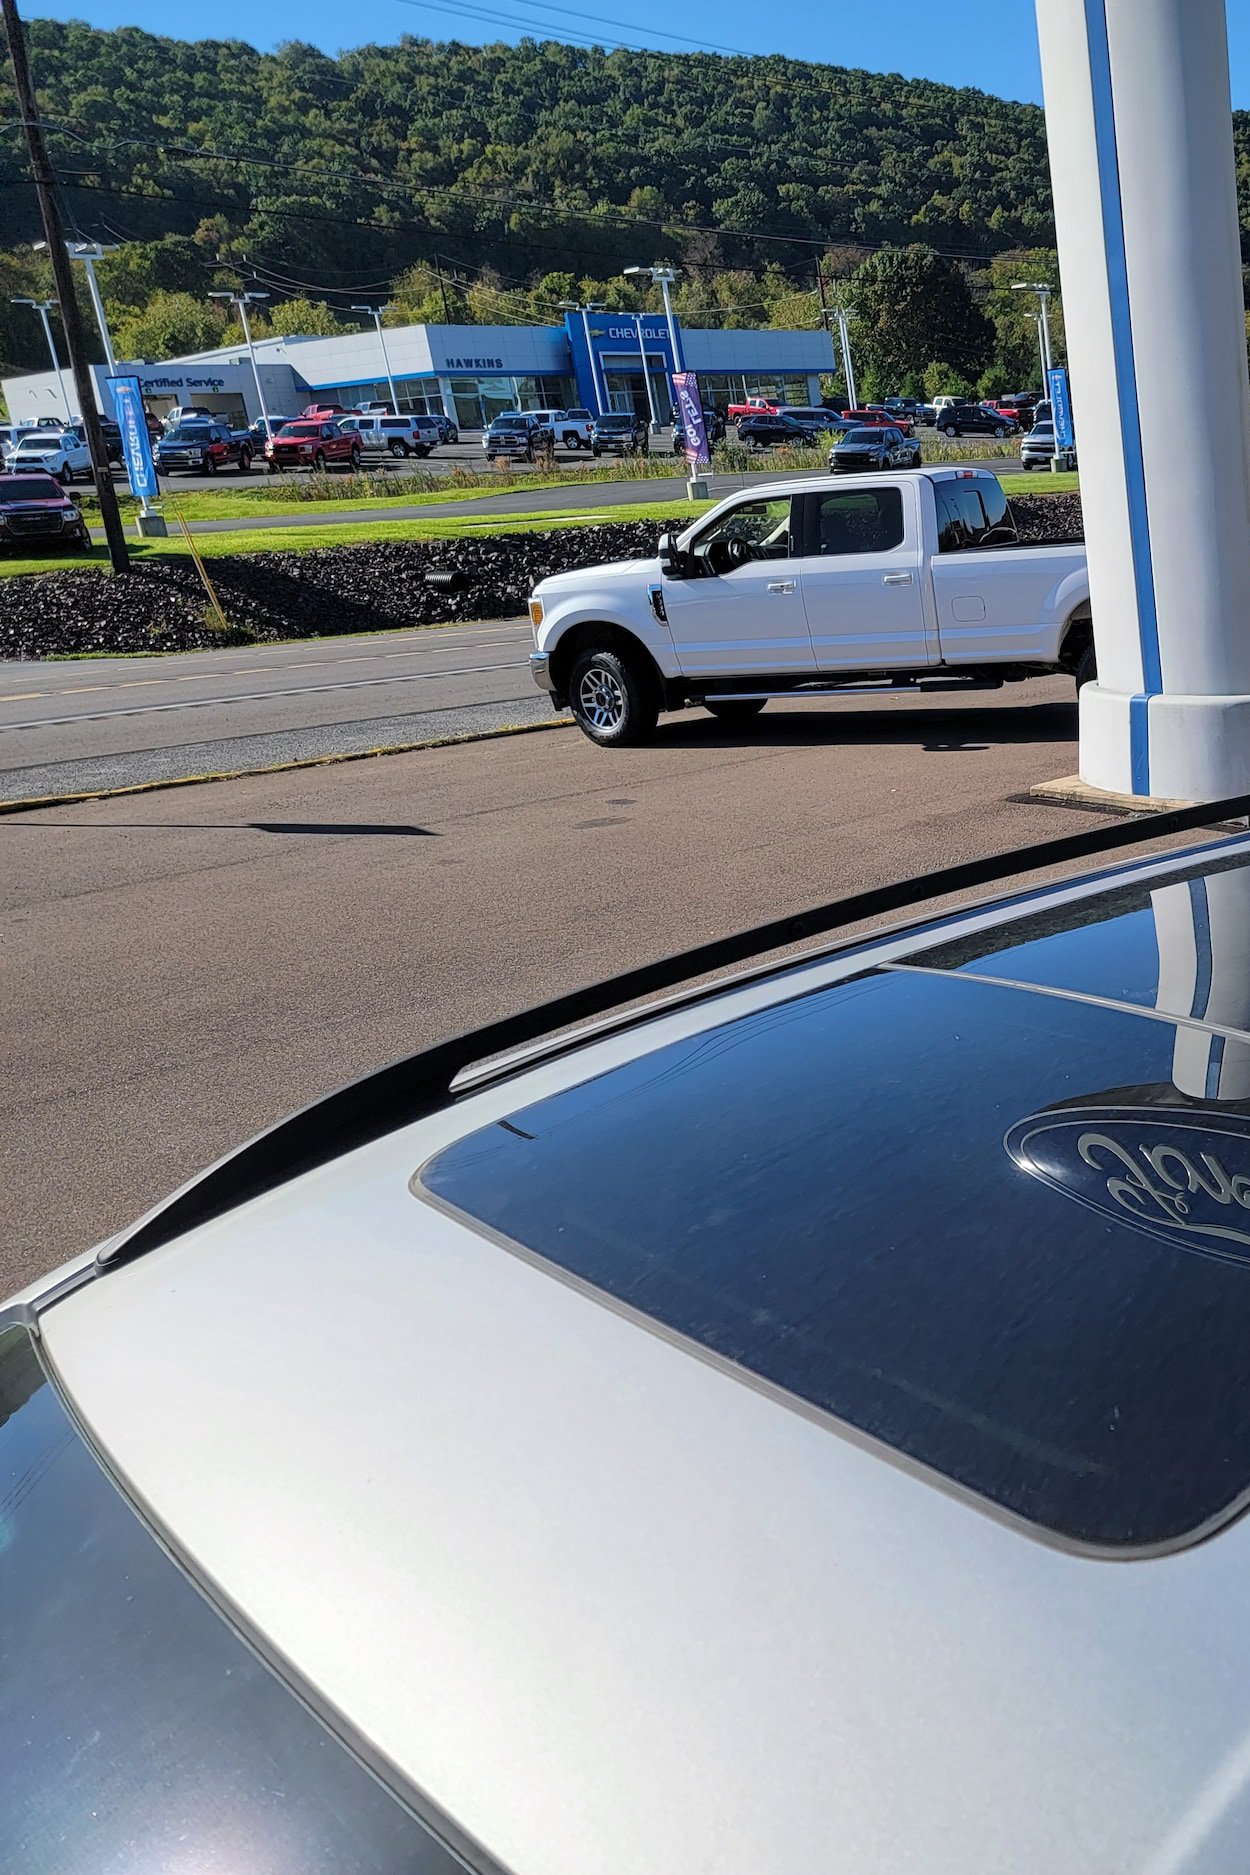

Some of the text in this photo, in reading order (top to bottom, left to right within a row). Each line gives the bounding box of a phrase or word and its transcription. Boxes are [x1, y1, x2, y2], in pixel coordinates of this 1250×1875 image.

[608, 328, 670, 339] CHEVROLET
[446, 358, 503, 368] HAWKINS
[186, 378, 225, 387] Service
